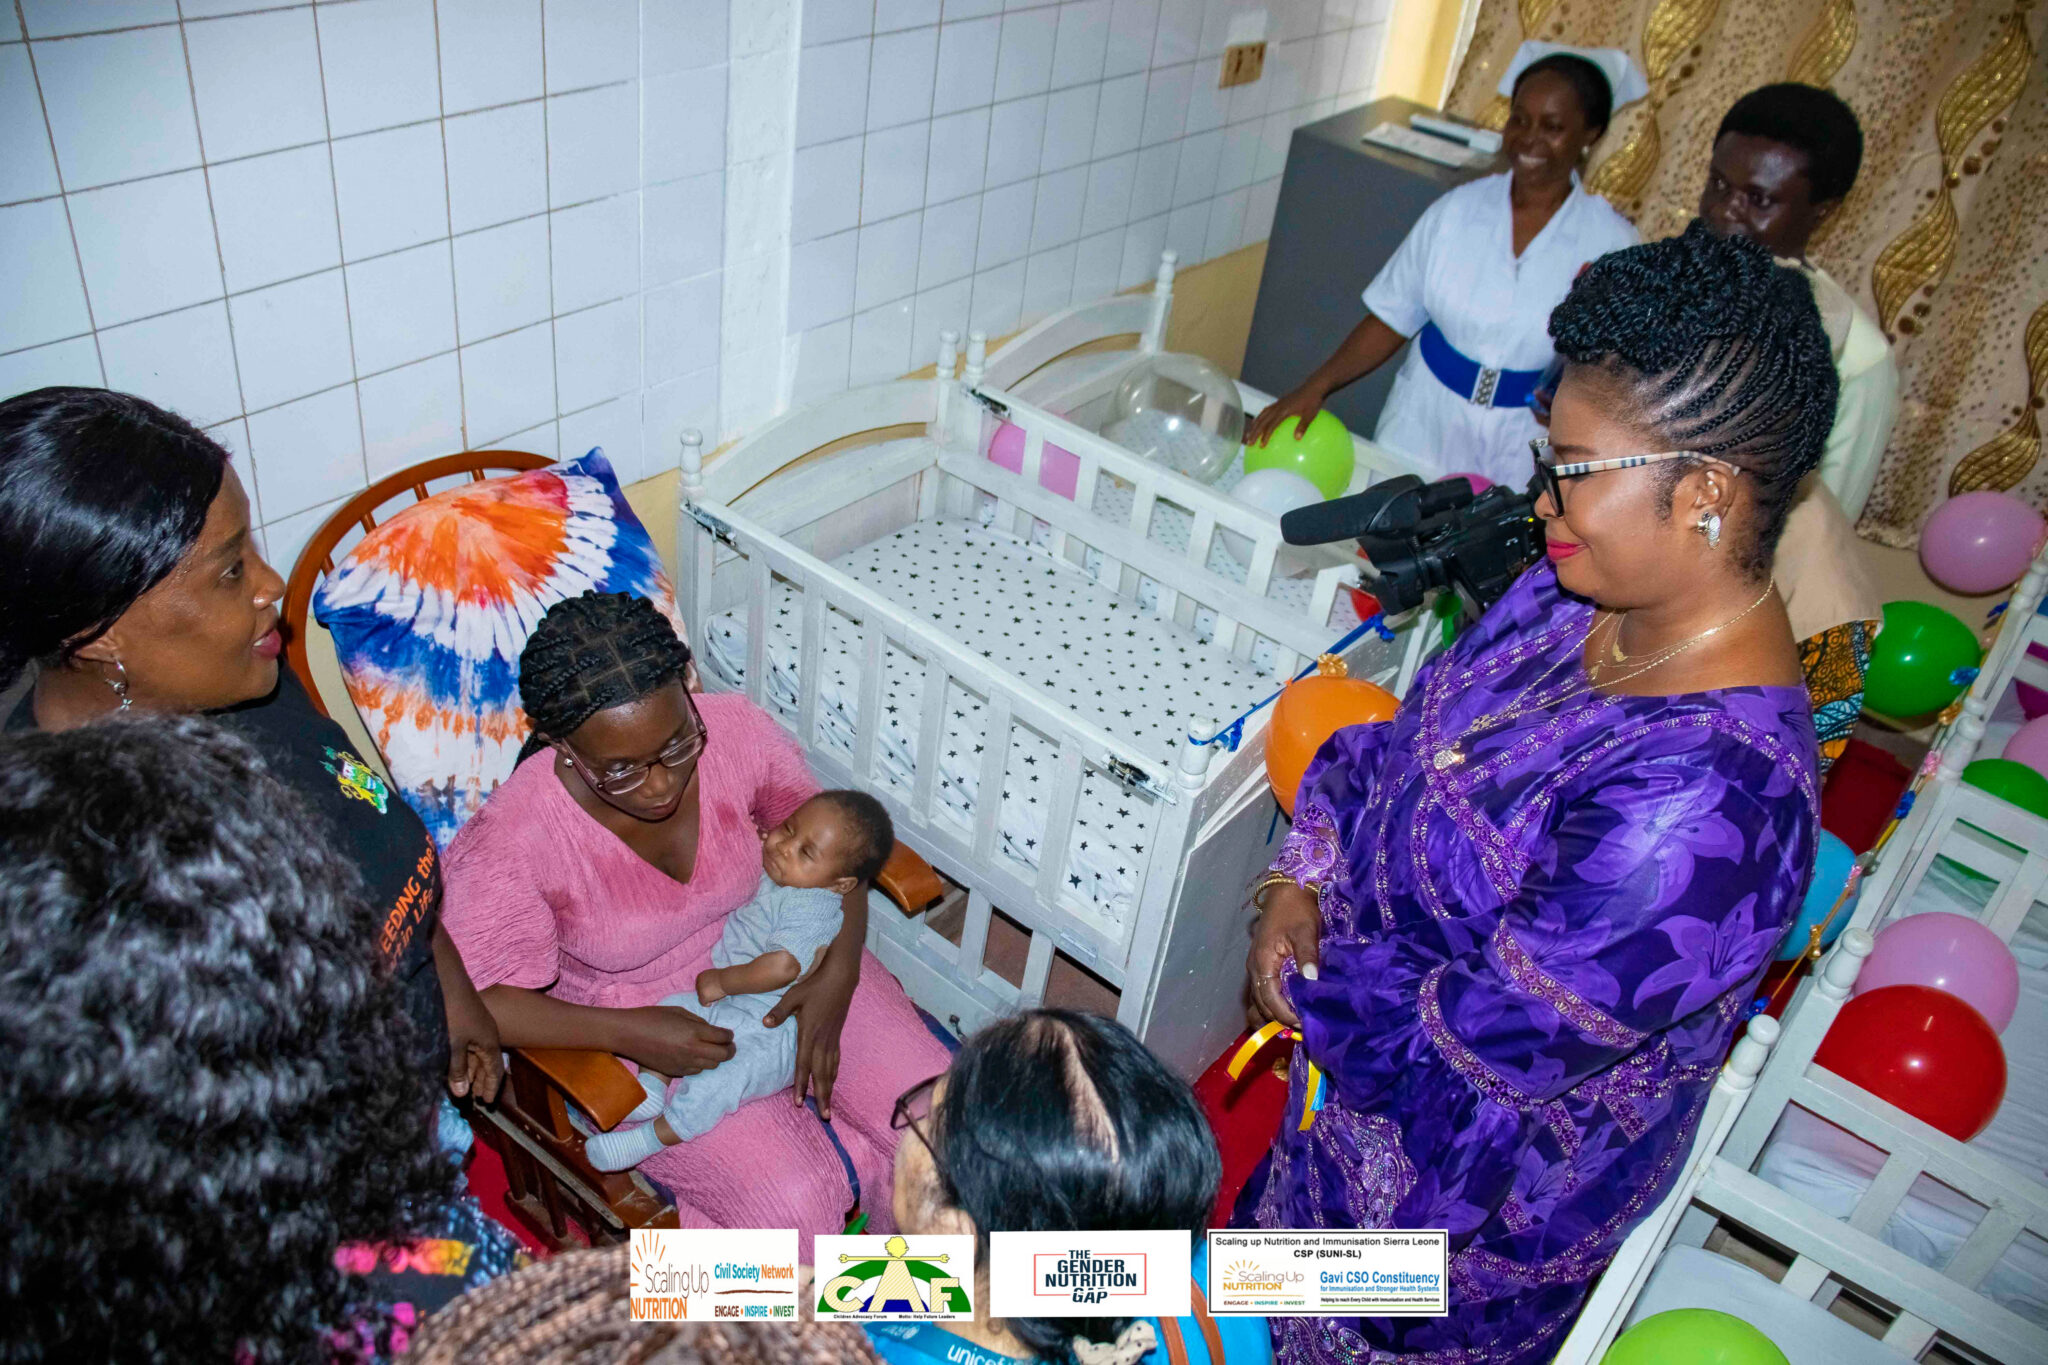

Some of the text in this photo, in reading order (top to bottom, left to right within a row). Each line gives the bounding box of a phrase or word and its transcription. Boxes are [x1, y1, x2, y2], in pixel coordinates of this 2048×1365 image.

[381, 876, 420, 954] EEDING
[417, 847, 435, 879] the
[947, 1344, 1005, 1365] unic
